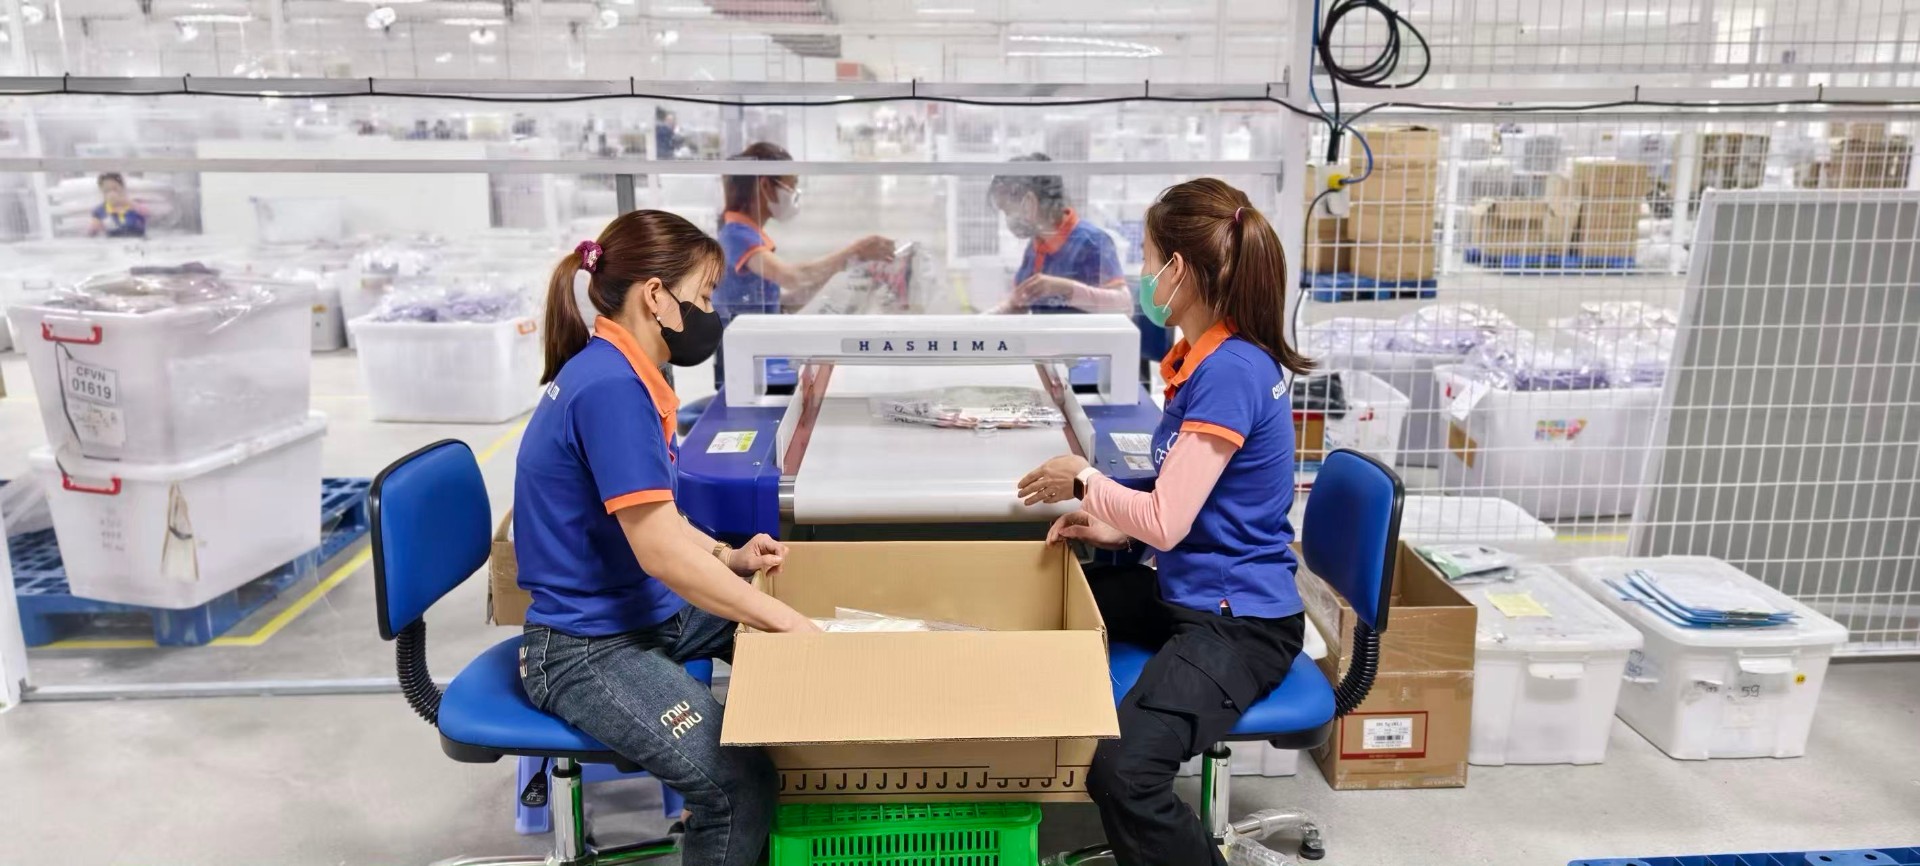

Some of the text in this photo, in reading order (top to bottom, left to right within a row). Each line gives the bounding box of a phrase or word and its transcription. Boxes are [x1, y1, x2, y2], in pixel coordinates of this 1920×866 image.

[859, 340, 1008, 351] HASHIMA
[76, 366, 106, 382] CFVN
[72, 378, 112, 399] 01619
[661, 701, 690, 726] miu
[672, 712, 703, 739] miu
